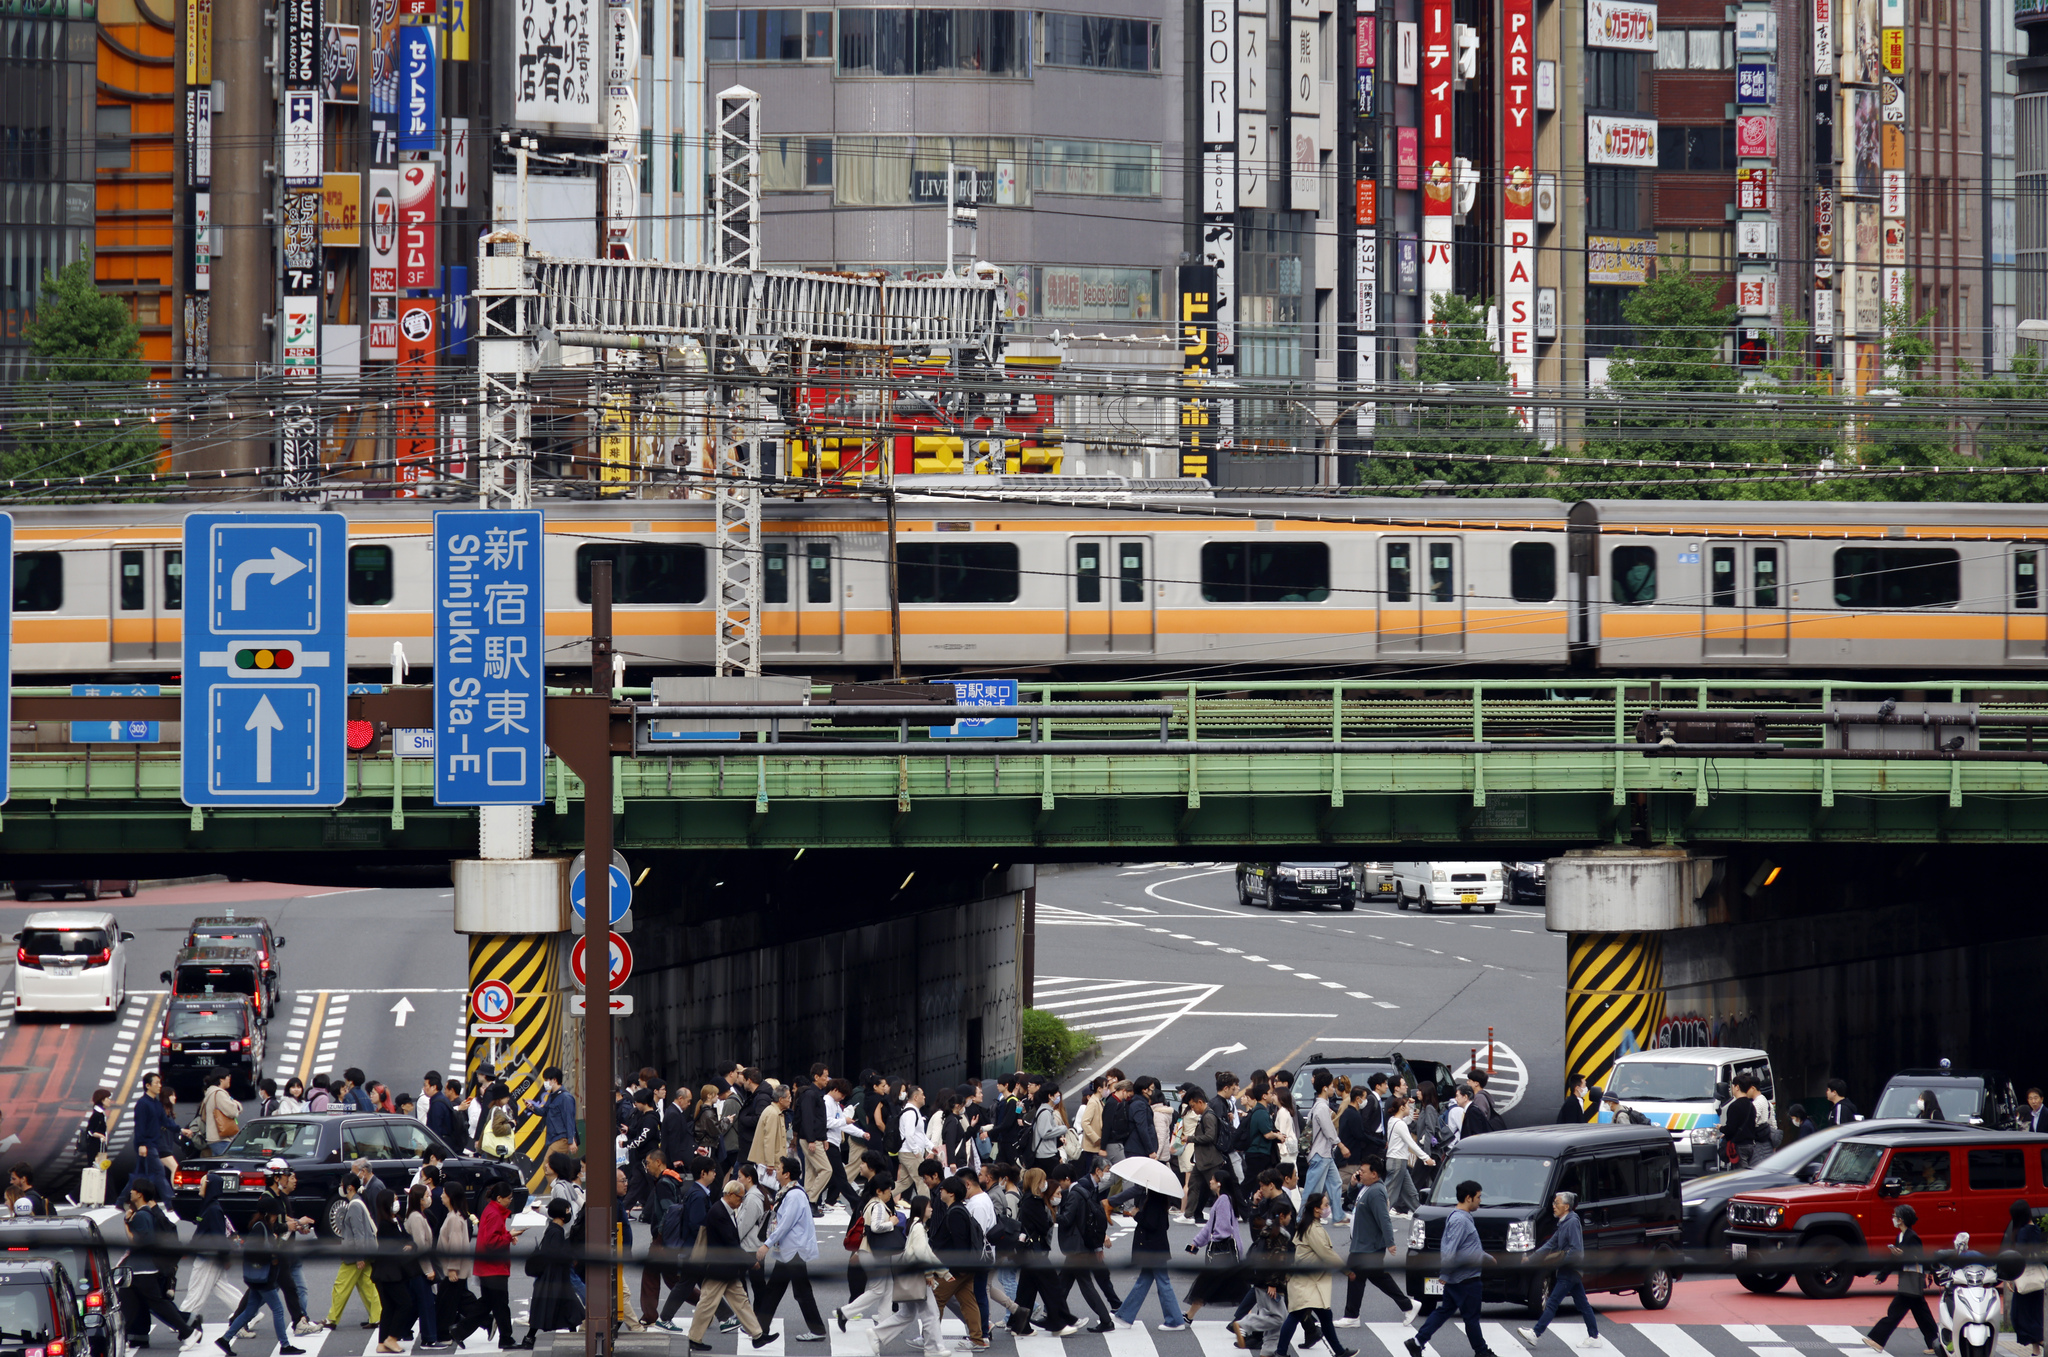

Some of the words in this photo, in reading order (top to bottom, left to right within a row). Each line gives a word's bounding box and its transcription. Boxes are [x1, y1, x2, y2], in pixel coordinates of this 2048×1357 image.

[289, 0, 297, 22] ARTS
[300, 0, 312, 29] UZZ
[411, 2, 425, 13] 5F
[1611, 10, 1647, 42] カラオケ
[289, 35, 297, 80] KARAOKE
[300, 31, 312, 80] STAND
[1300, 30, 1311, 101] 熊の
[1817, 58, 1831, 73] 7F
[611, 69, 627, 79] 6F
[1210, 10, 1227, 133] BORI
[1510, 14, 1527, 127] PARTY
[1740, 71, 1764, 84] 麻雀
[410, 40, 426, 135] セントラル
[1887, 111, 1903, 120] UP
[292, 125, 300, 167] クリニック
[372, 120, 396, 164] 7F
[1611, 125, 1648, 159] カラオケ
[920, 180, 949, 196] LIVE
[959, 180, 993, 197] HOUSE
[1215, 154, 1223, 211] ESOLA
[1295, 179, 1316, 192] KIBORI
[301, 195, 313, 247] ビアポン
[343, 205, 356, 231] 6F
[407, 211, 425, 267] アコム
[289, 271, 313, 288] 7F
[373, 270, 395, 290] たばこ
[408, 271, 424, 283] 3F
[1083, 280, 1105, 304] Bebas
[378, 298, 388, 318] 酒
[372, 325, 395, 346] ATM
[1815, 335, 1833, 344] 4F
[289, 348, 310, 356] たばこ
[289, 368, 309, 376] ATM
[443, 534, 480, 663] Shinjuku
[483, 526, 530, 786] 新宿駅東口
[955, 683, 1010, 698] 宿駅東口
[131, 724, 145, 733] 302
[414, 736, 433, 749] Shi
[223, 1180, 236, 1189] 1-31
